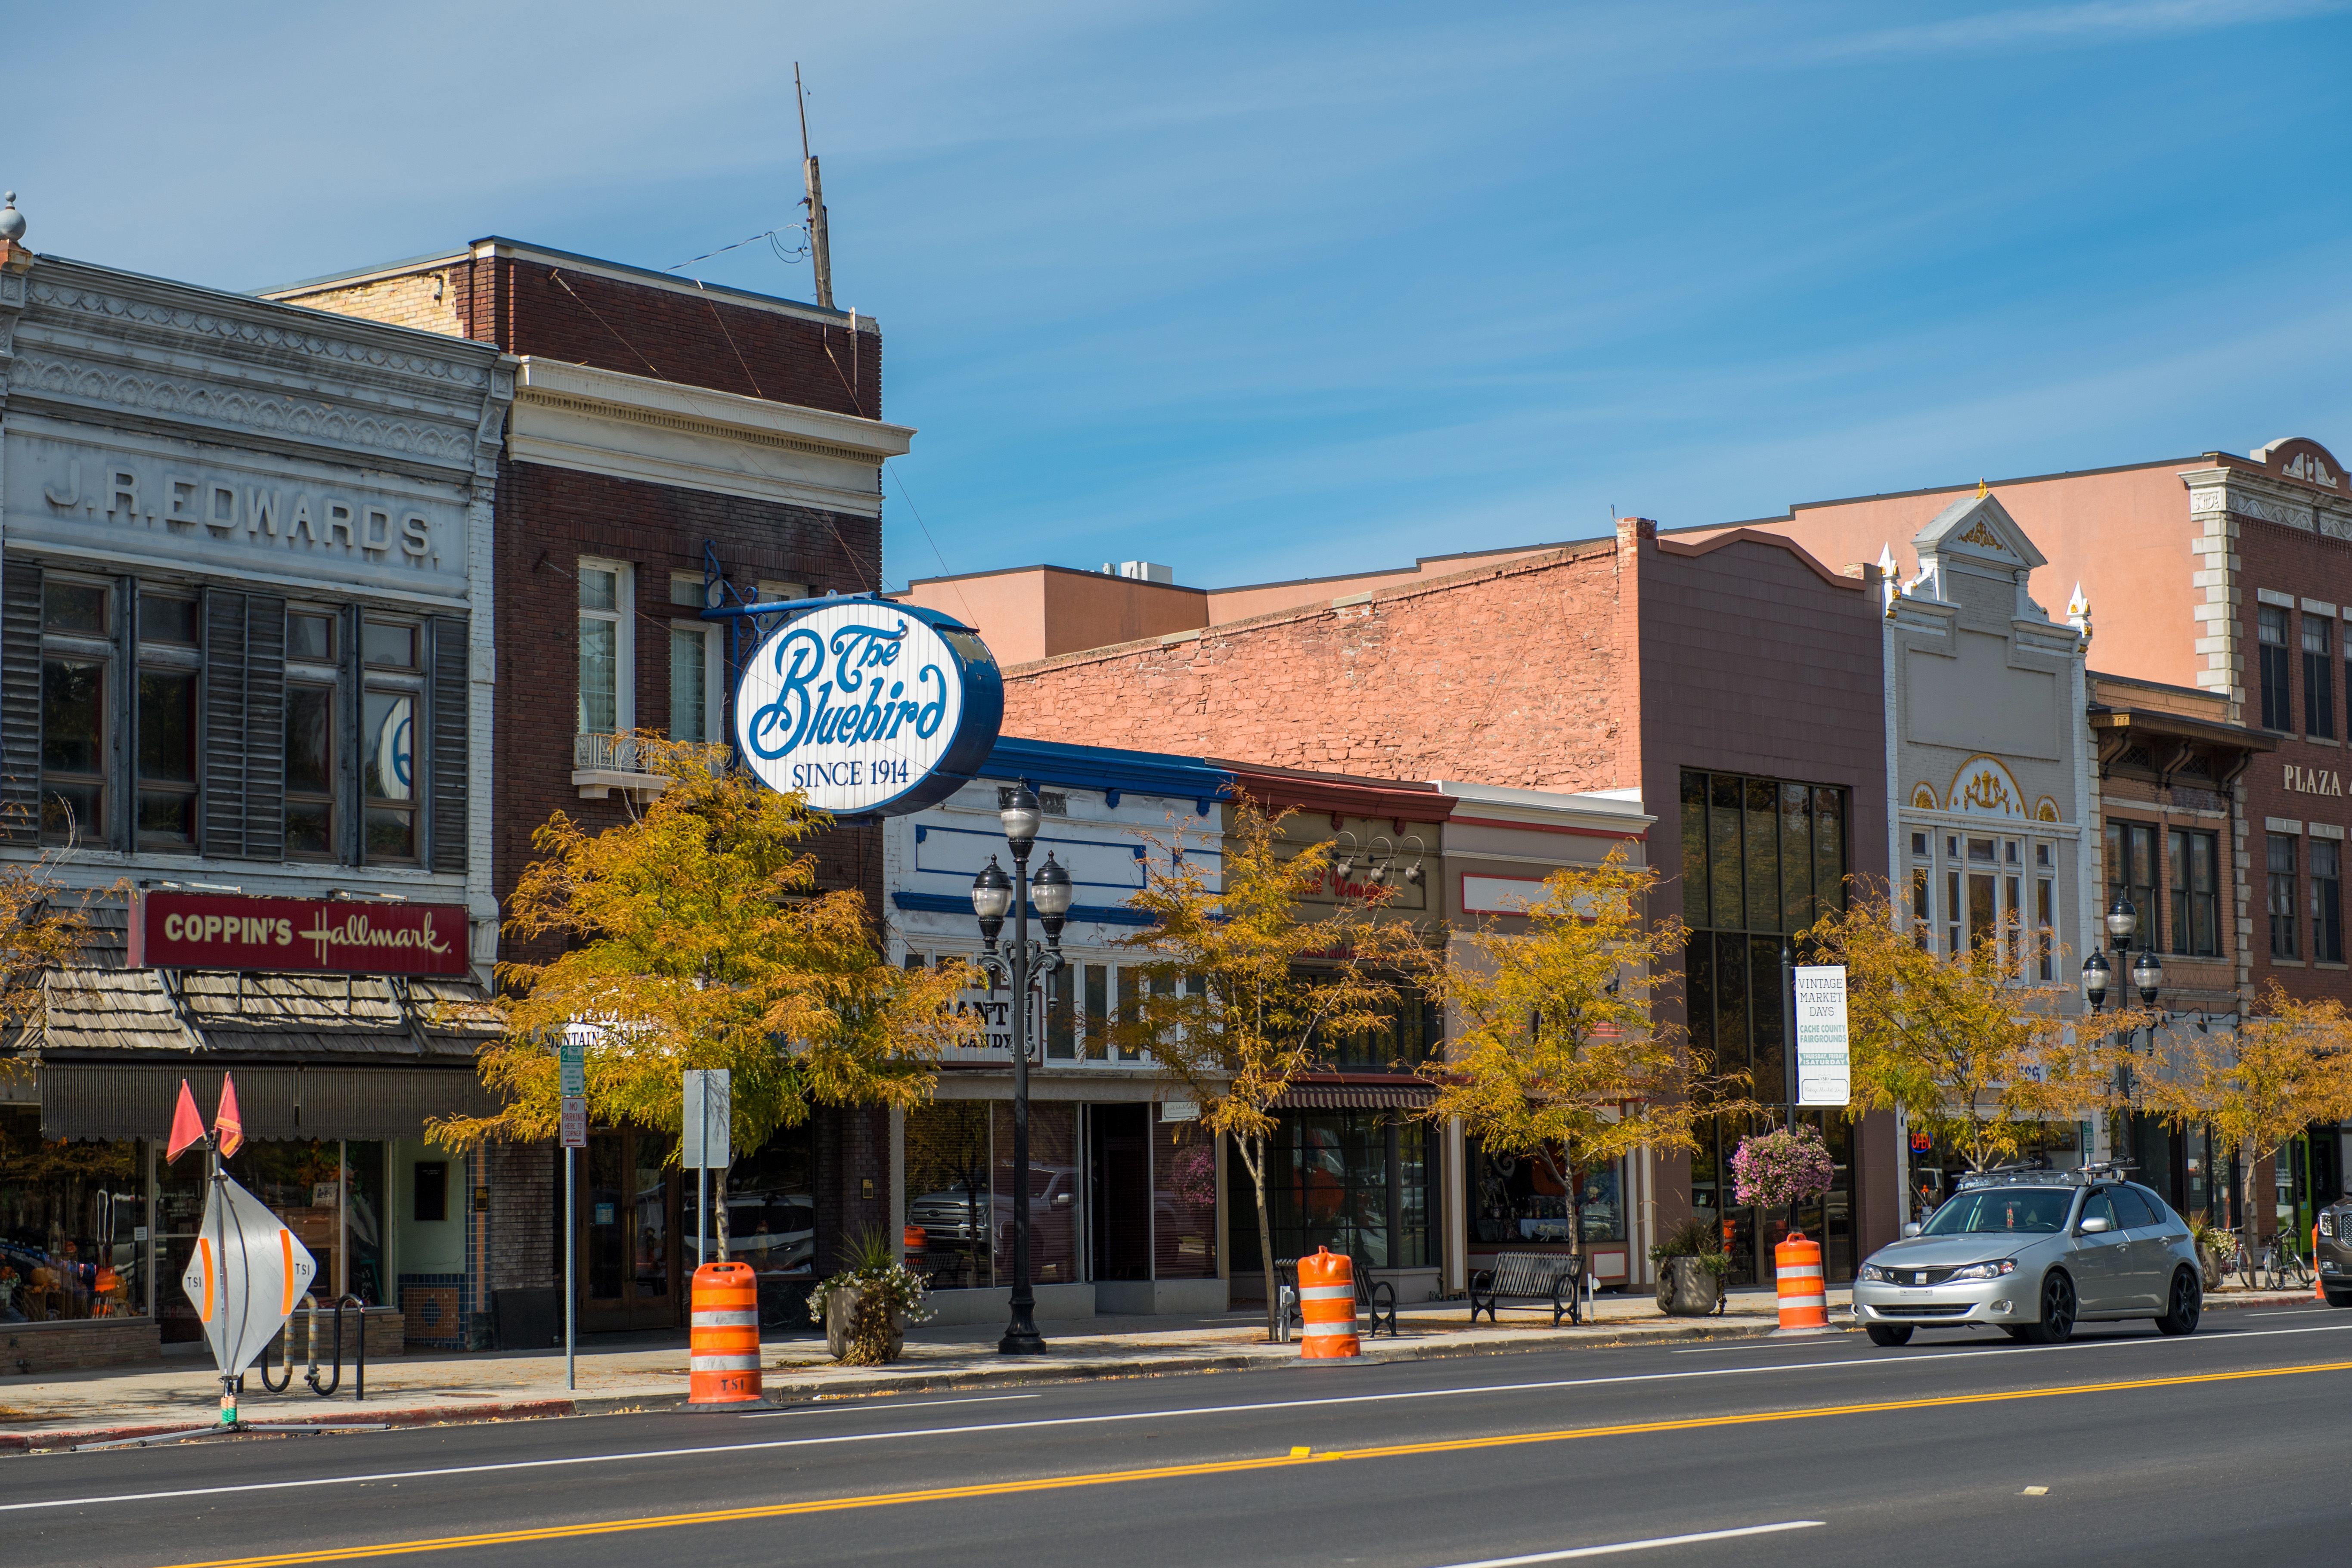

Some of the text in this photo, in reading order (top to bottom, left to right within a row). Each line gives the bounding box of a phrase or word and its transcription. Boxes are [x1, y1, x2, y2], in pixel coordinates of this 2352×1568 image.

[830, 619, 907, 693] The
[749, 629, 947, 760] Bluebird
[792, 758, 909, 787] SINCE 1914
[2282, 764, 2342, 796] PLAZA
[164, 913, 293, 946] COPPIN'S
[1798, 979, 1843, 989] VINTAGE
[1800, 992, 1842, 1002] MARKET
[1809, 1007, 1834, 1016] DAYS
[1800, 1024, 1846, 1033] CACHE COUNTY
[546, 1032, 600, 1048] OUNTAIN
[1800, 1035, 1847, 1043] FAIRGROUNDS
[562, 1048, 567, 1060] 2
[569, 1102, 578, 1111] NO
[563, 1112, 585, 1122] PARKING
[1912, 1133, 1931, 1149] OPEN
[295, 1263, 310, 1276] TSI
[187, 1277, 201, 1288] TSI
[722, 1379, 744, 1391] TSI
